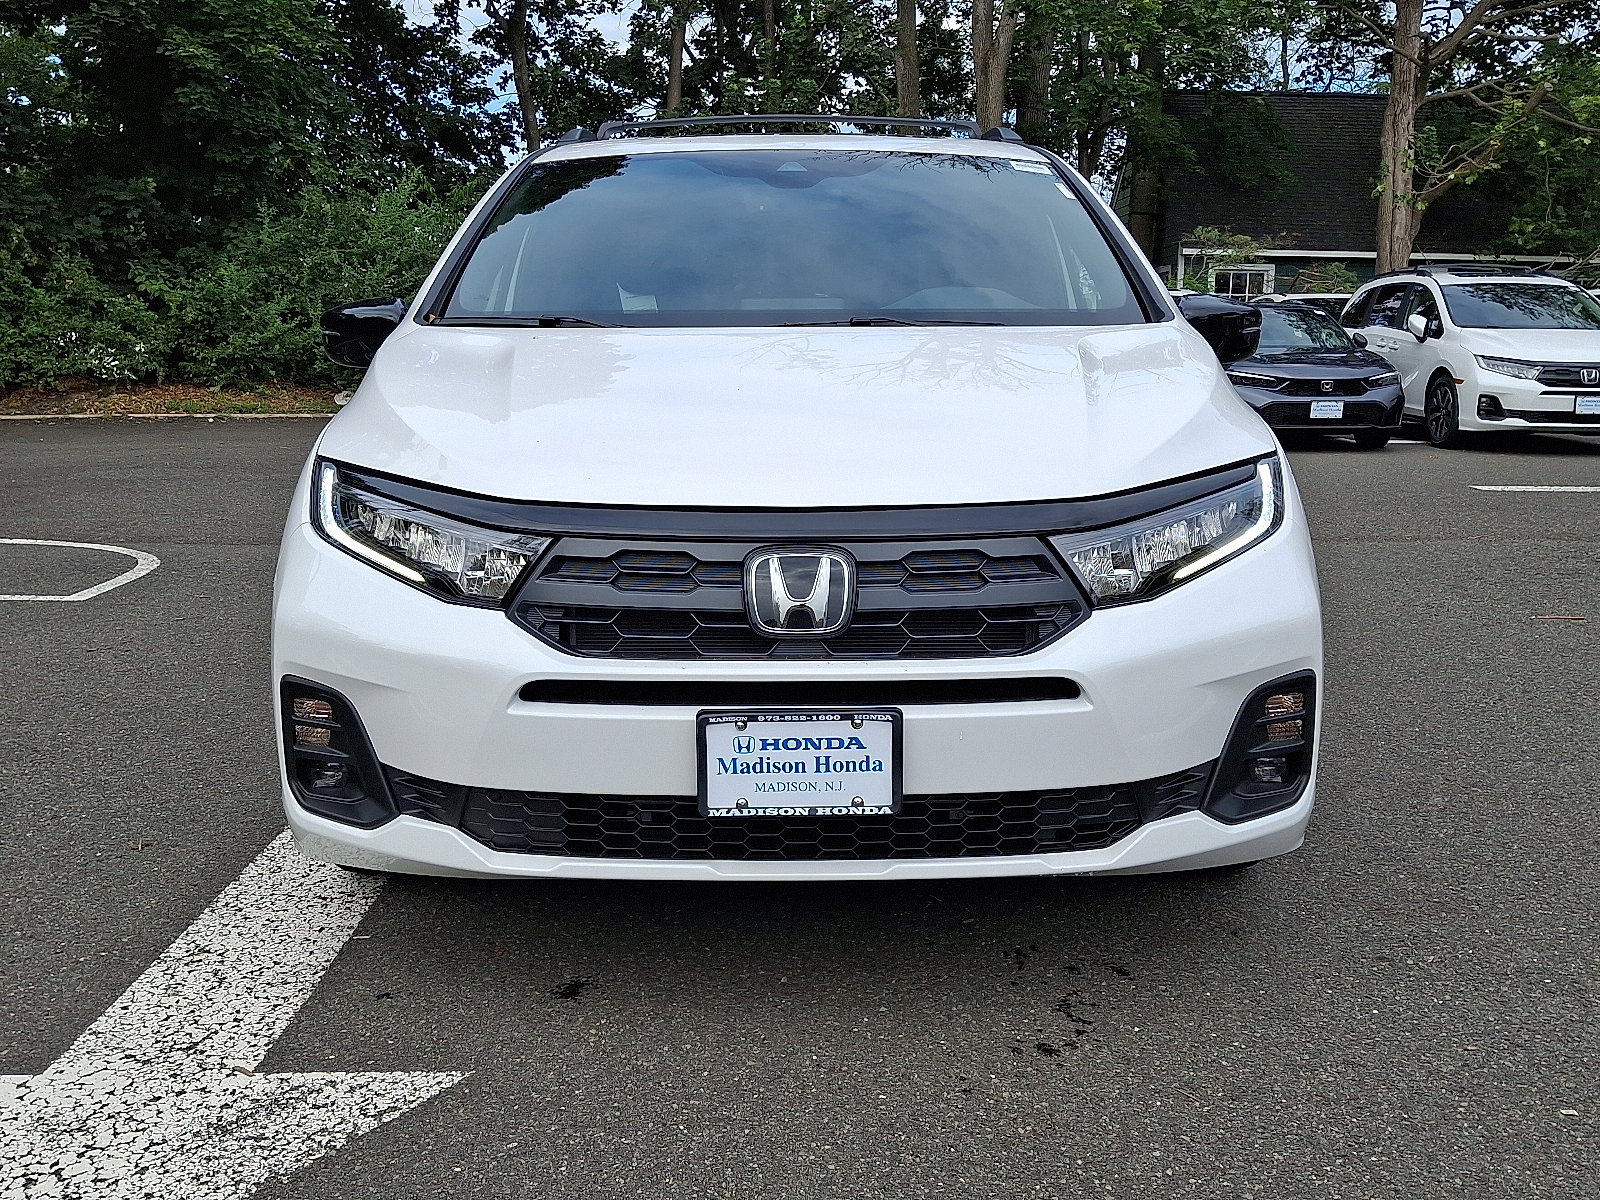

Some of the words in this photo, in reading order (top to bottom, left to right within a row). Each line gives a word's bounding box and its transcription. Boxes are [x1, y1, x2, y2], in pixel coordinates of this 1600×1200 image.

[759, 736, 867, 751] HONDA
[716, 756, 808, 775] Madison
[813, 755, 884, 774] Honda
[754, 782, 822, 794] MADISON,
[824, 781, 847, 792] N.J.
[707, 807, 811, 817] MADISON
[816, 806, 894, 815] HONDA
